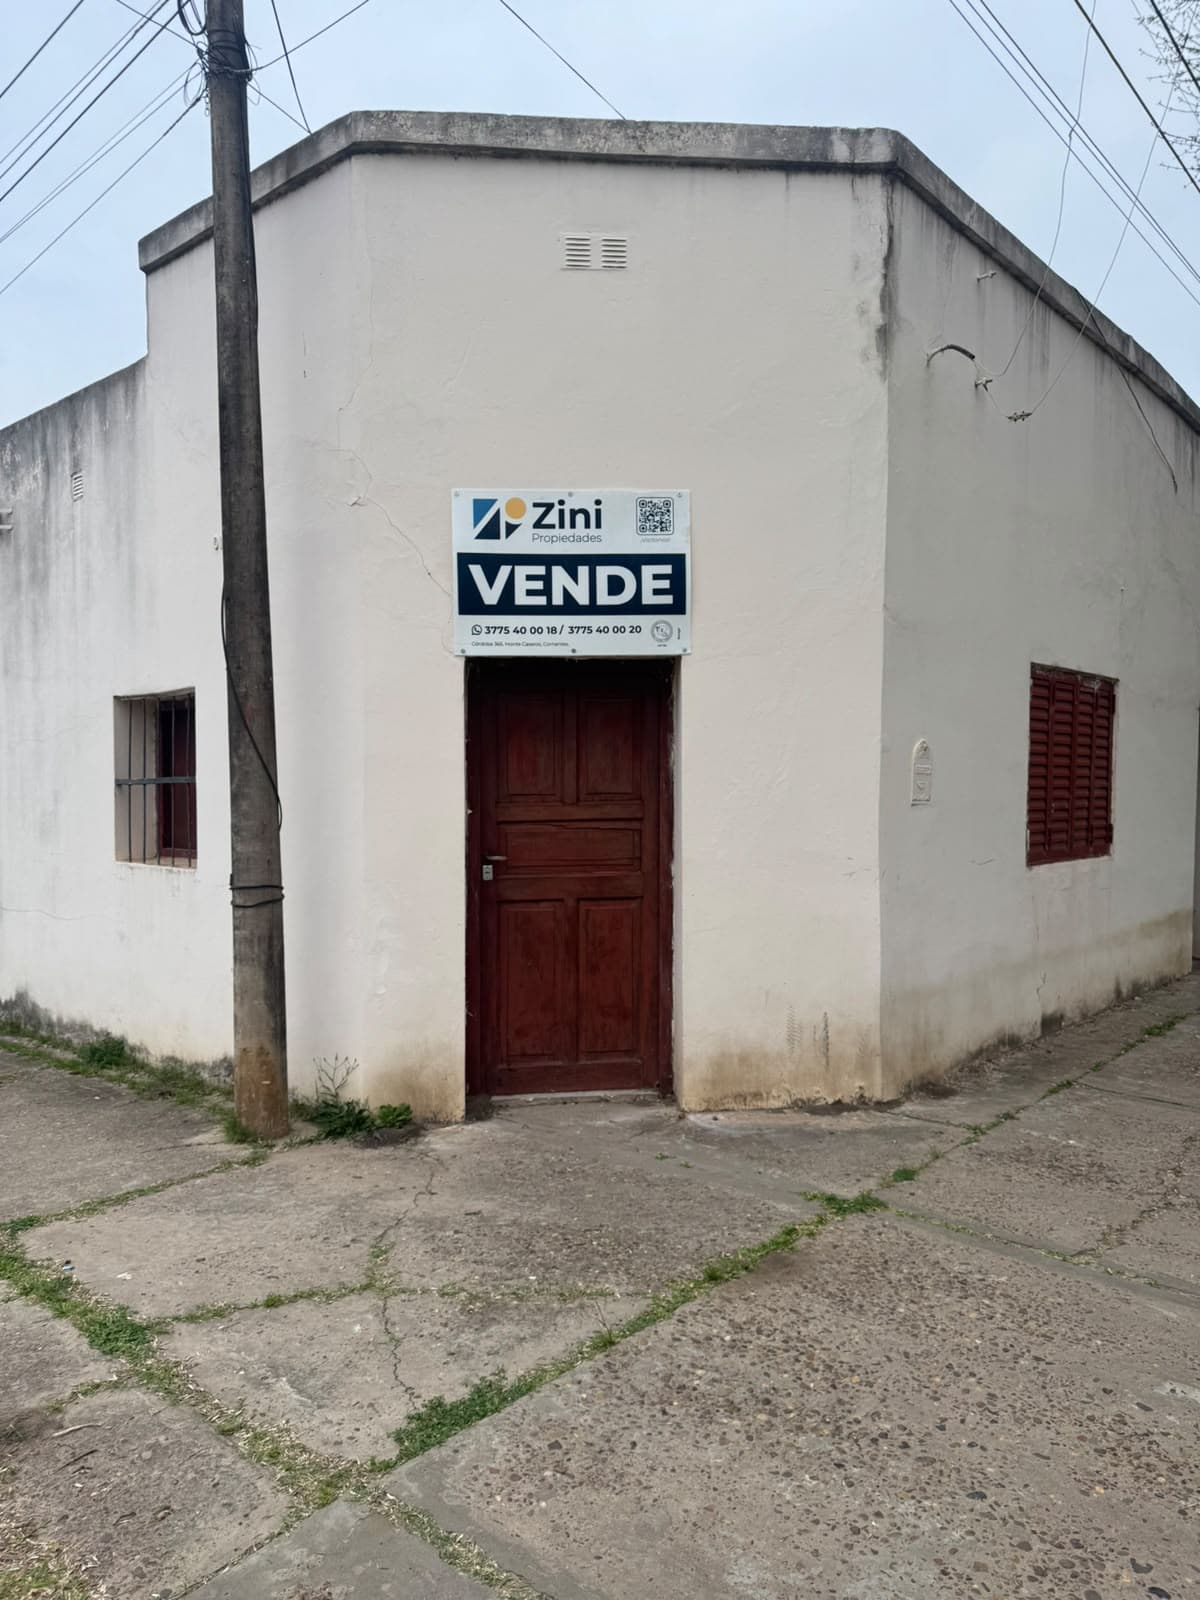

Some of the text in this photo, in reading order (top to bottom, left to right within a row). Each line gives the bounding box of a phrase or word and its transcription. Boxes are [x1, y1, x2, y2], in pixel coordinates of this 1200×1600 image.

[532, 498, 603, 530] Zini
[531, 532, 603, 545] Propiedades
[467, 564, 674, 607] VENDE
[484, 625, 510, 635] 3775
[512, 625, 527, 635] 40
[529, 625, 544, 635] 00
[567, 625, 593, 635] 3775
[595, 625, 610, 635] 40
[612, 625, 626, 635] 00
[628, 624, 642, 634] 20
